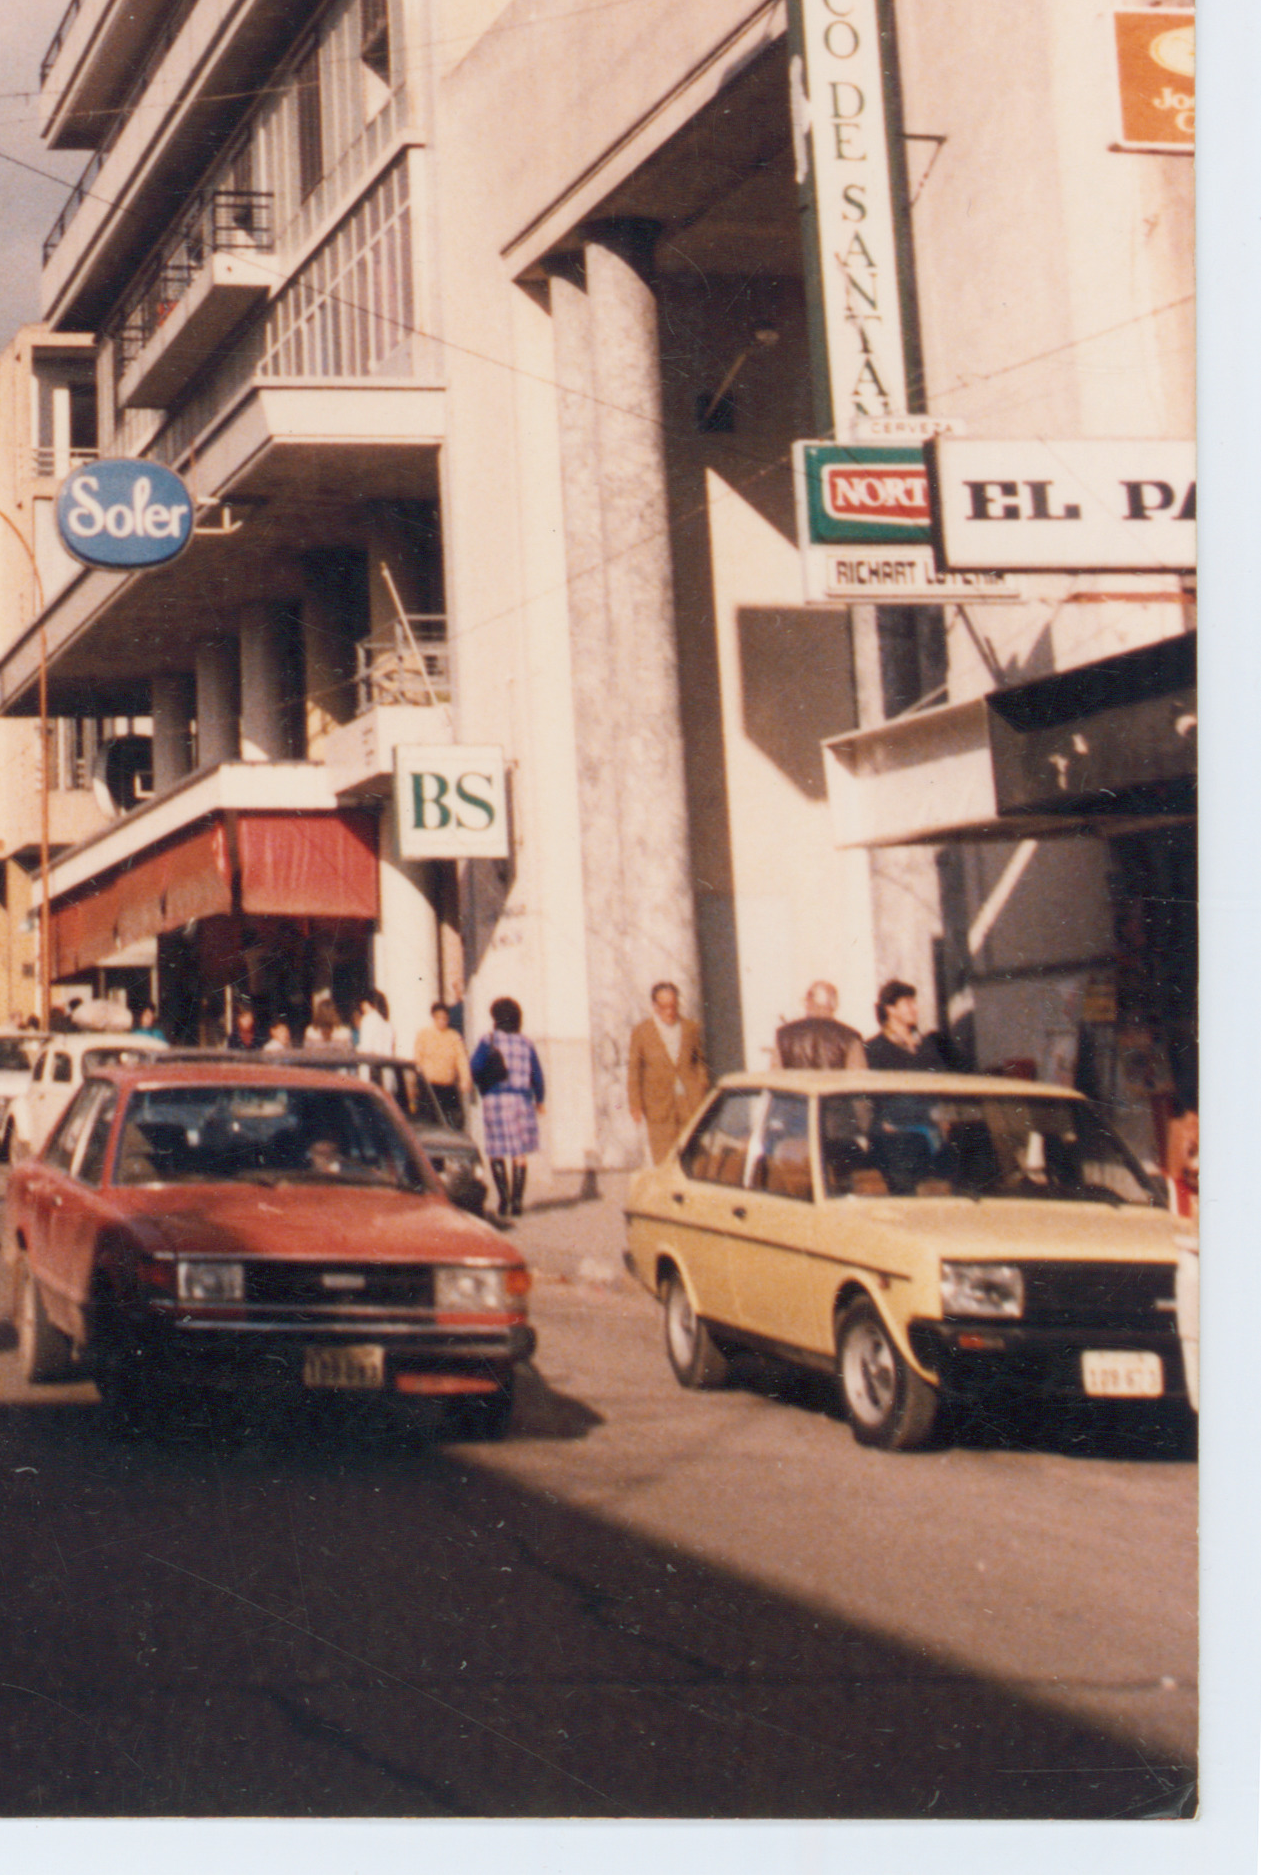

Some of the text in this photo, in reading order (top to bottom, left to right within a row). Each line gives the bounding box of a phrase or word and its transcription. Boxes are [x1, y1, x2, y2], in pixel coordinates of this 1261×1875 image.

[1152, 86, 1195, 110] Jo
[828, 80, 867, 162] DE
[869, 421, 955, 435] CERVEZA
[68, 475, 189, 538] Soler
[962, 479, 1083, 521] EL
[836, 560, 916, 585] RICHART
[409, 771, 495, 831] BS
